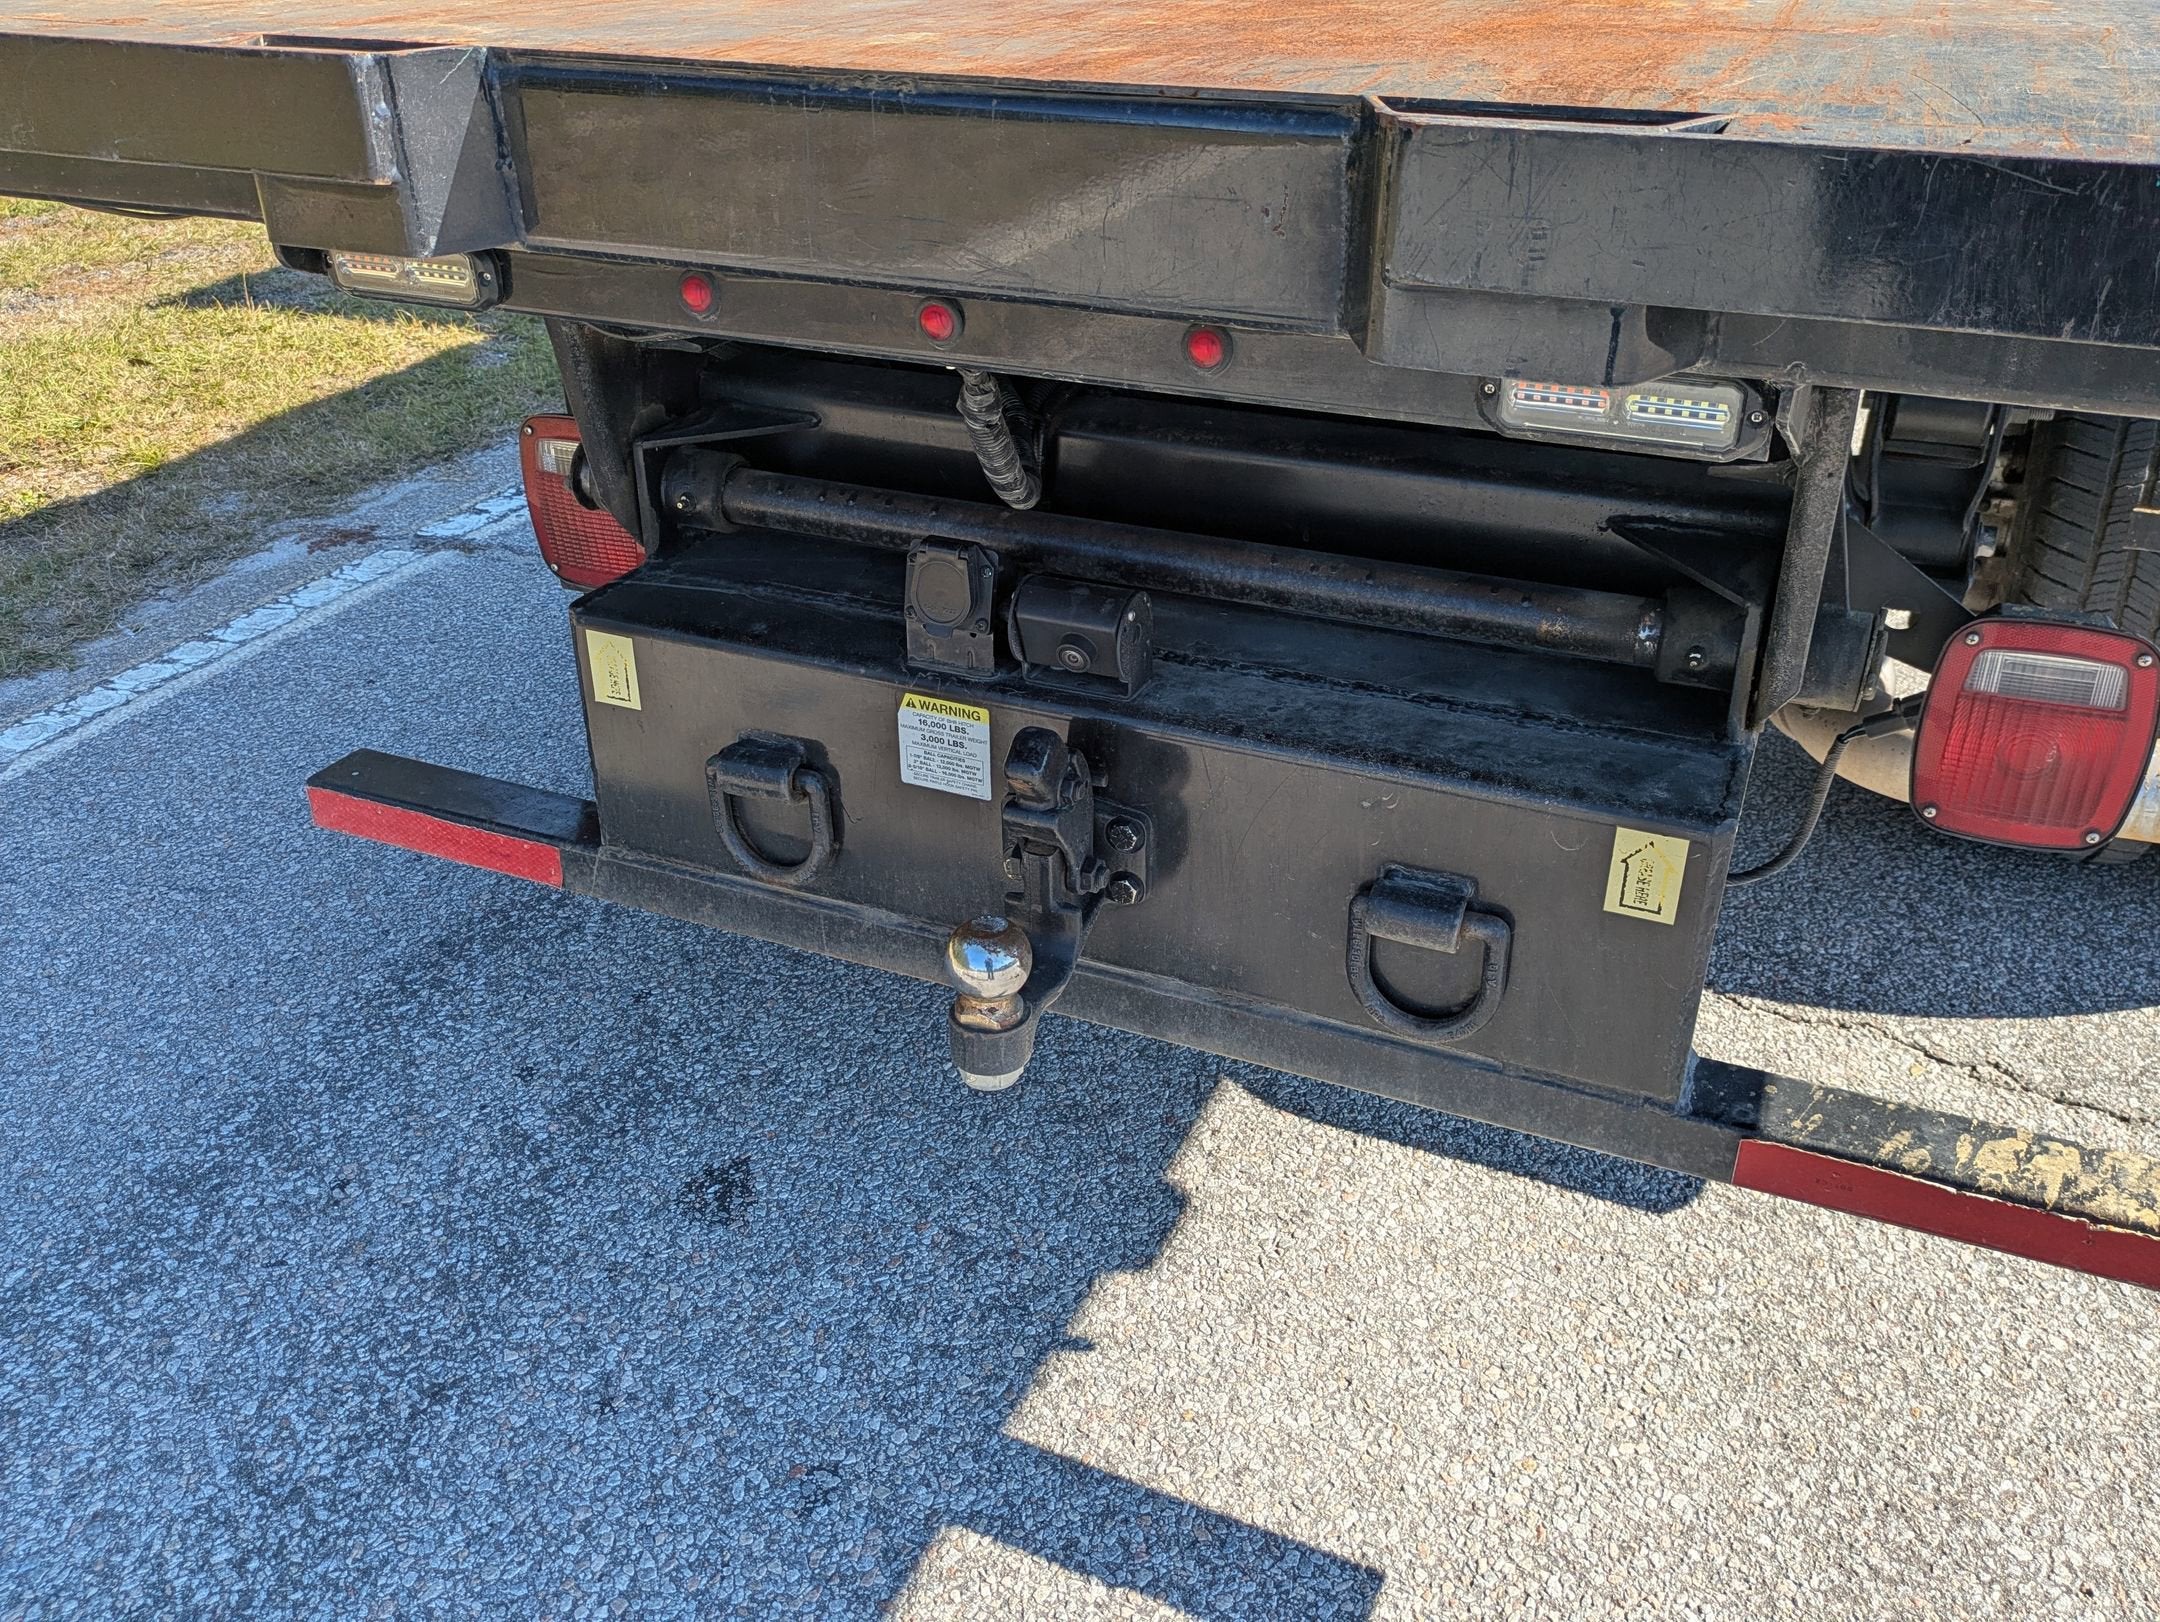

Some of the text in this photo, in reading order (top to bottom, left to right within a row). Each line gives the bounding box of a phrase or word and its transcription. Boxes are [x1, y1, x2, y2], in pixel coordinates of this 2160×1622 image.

[912, 711, 938, 721] CAPACITY
[918, 700, 981, 721] WARNING
[900, 723, 987, 745] MAXIMUM GROSS TRAILER WEIGHT
[918, 719, 970, 735] 16,000 LBS.
[912, 740, 937, 749] MAXIMUM
[938, 746, 962, 754] VERTICAL
[920, 733, 968, 749] 3,000 LBS.
[937, 753, 966, 762] CAPACITIES
